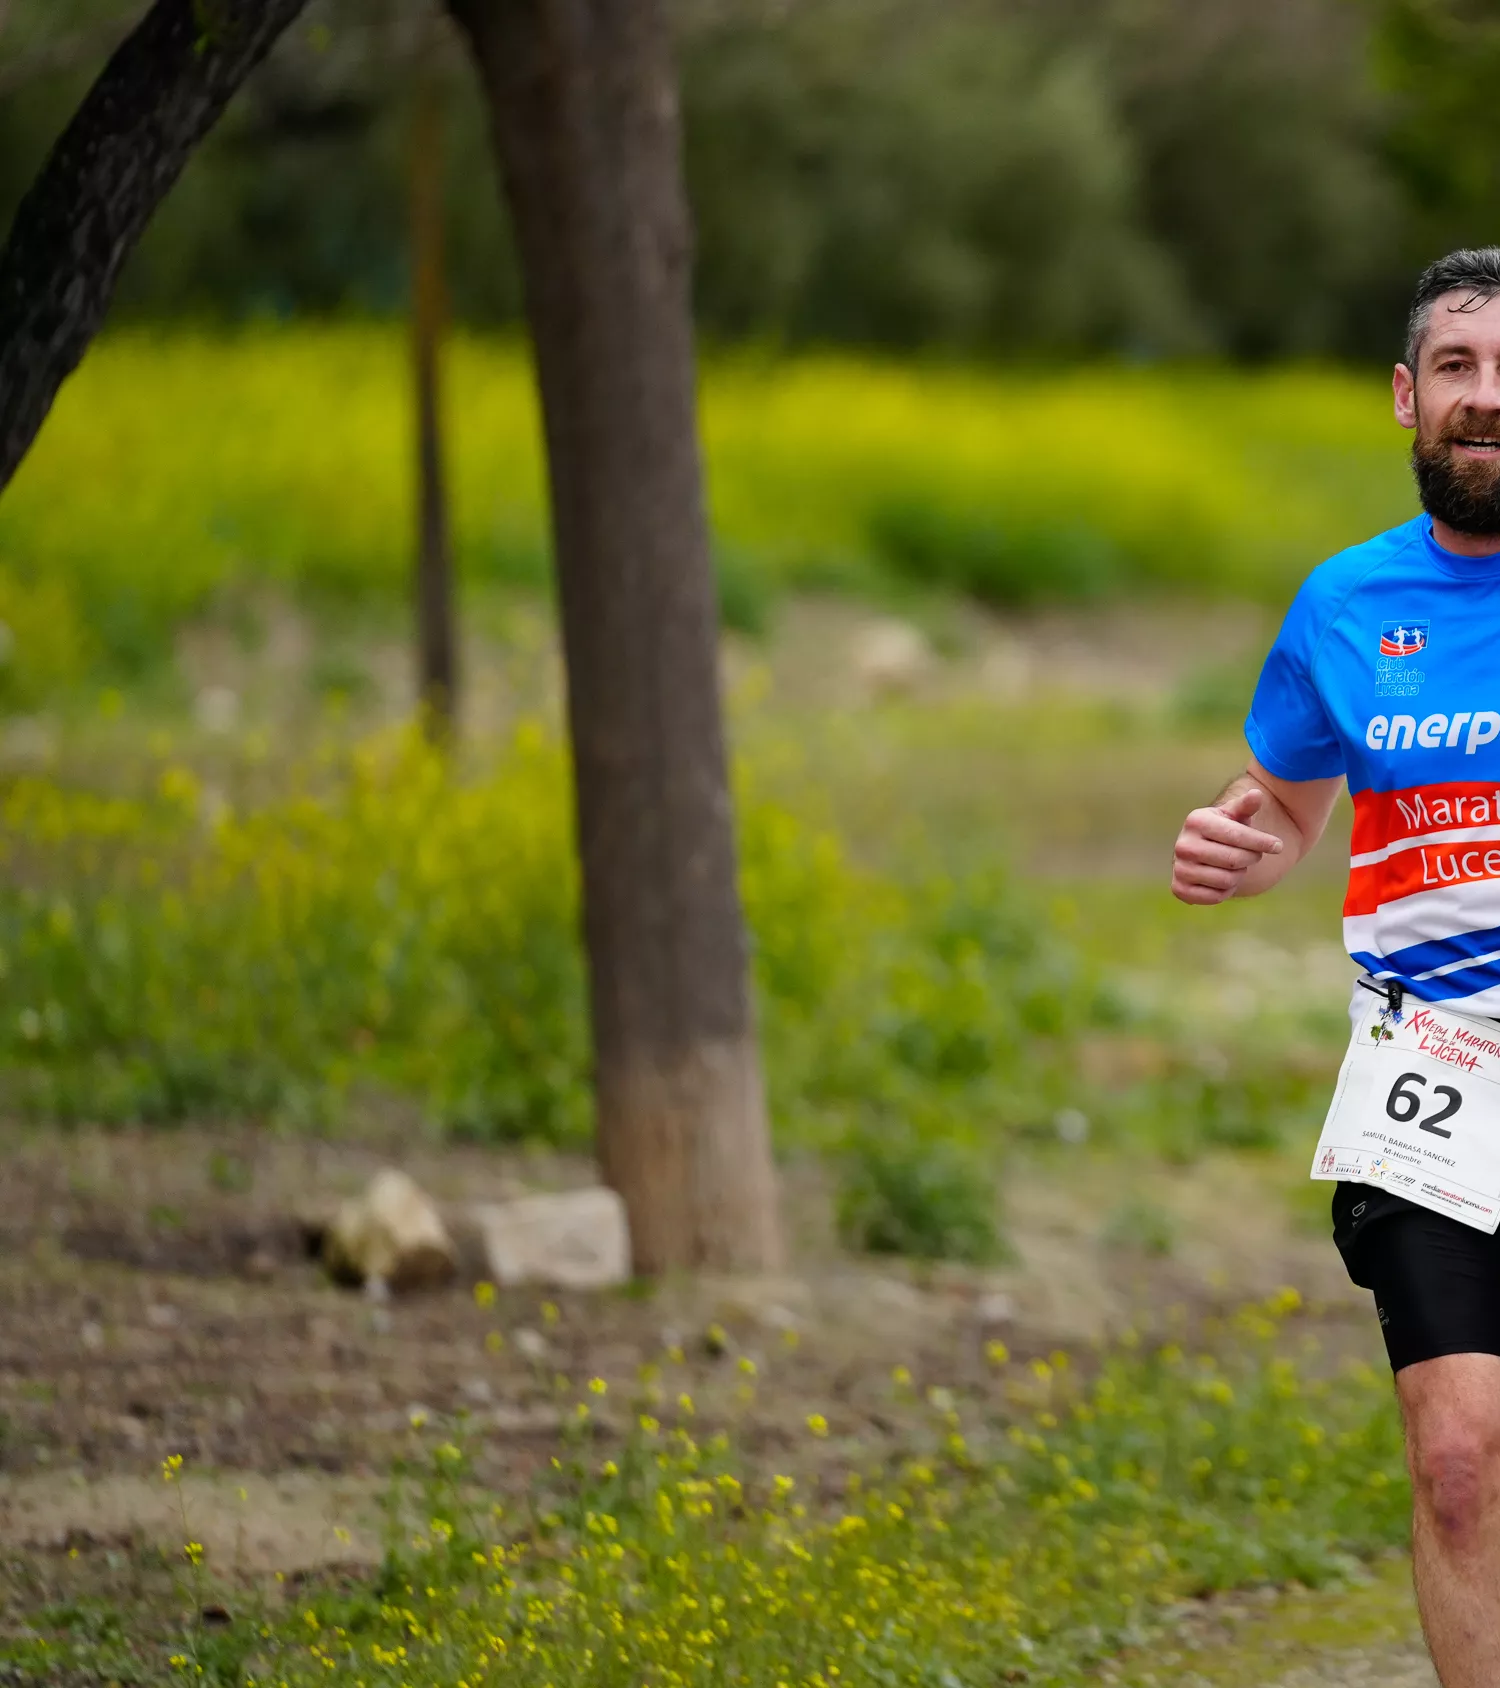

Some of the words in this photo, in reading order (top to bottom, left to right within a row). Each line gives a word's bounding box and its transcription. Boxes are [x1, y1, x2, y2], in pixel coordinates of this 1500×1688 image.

[1418, 1033, 1483, 1072] LUCENA
[1385, 1072, 1463, 1139] 62
[1362, 1130, 1387, 1142] SAMUEL
[1388, 1137, 1421, 1154] BARRASA
[1423, 1149, 1456, 1168] SANCHEZ
[1383, 1147, 1422, 1165] M-Hombre
[1422, 1182, 1493, 1214] mediamaratonlucena.com
